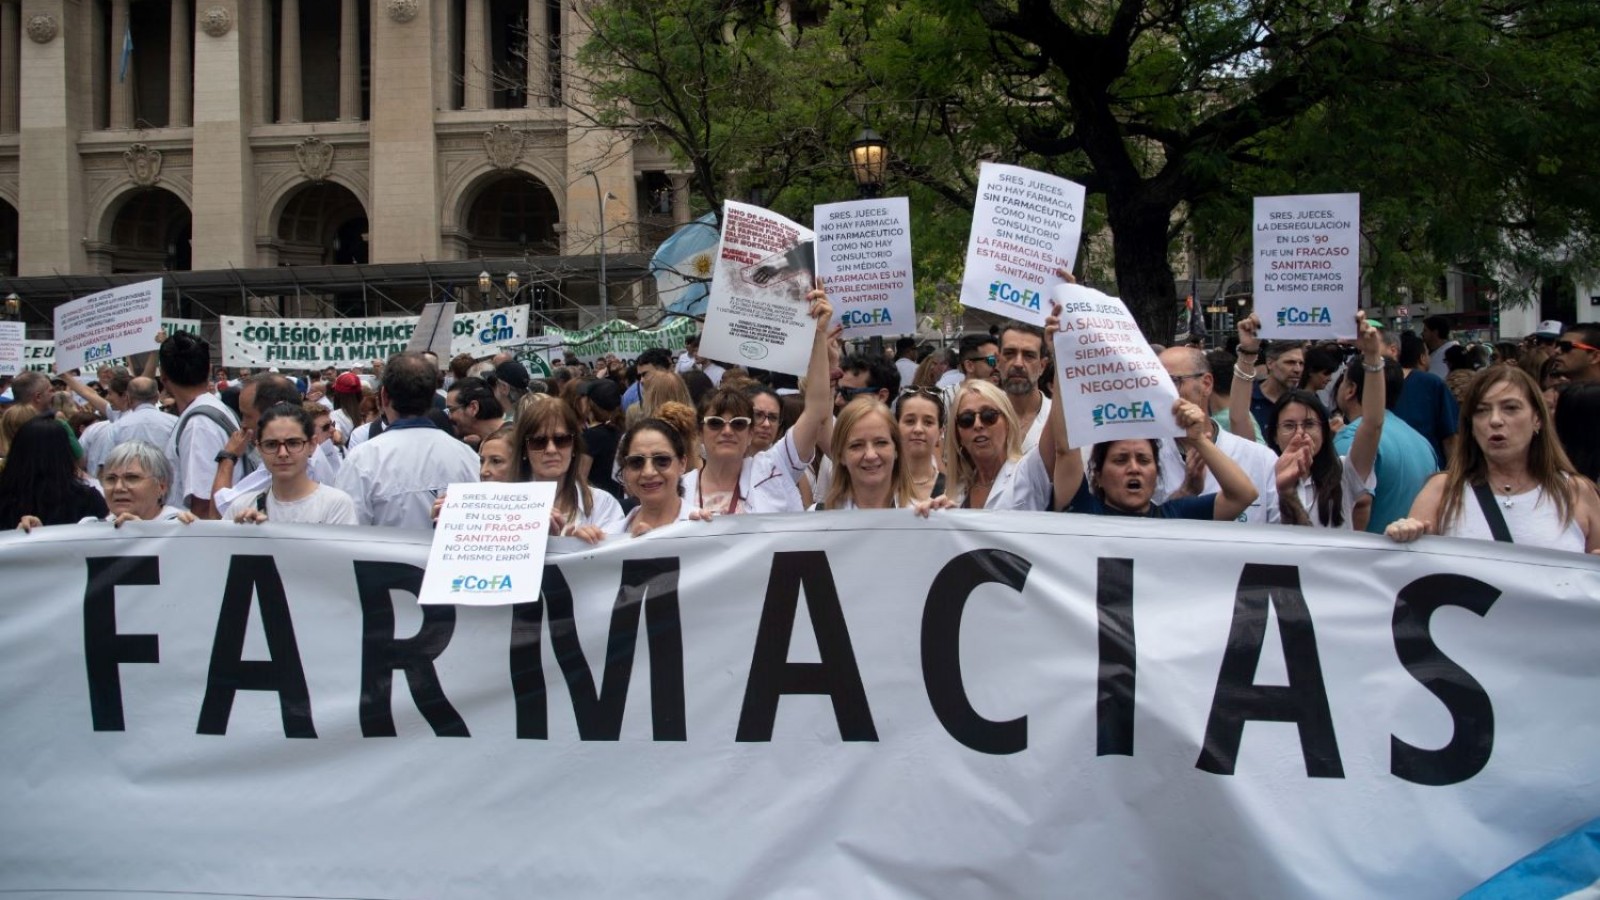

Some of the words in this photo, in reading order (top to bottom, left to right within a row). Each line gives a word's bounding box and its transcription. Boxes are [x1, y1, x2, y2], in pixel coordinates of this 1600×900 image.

[999, 174, 1026, 187] SRES.
[983, 192, 1000, 202] SIN
[1005, 186, 1025, 196] HAY
[1026, 191, 1073, 210] FARMACIA
[728, 208, 745, 217] UNO
[830, 211, 852, 220] SRES.
[994, 206, 1025, 219] COMO
[1027, 214, 1041, 223] NO
[1044, 220, 1062, 230] HAY
[1297, 210, 1334, 219] JUECES:
[855, 218, 899, 229] FARMACIA
[992, 217, 1060, 241] CONSULTORIO
[1258, 223, 1268, 231] LA
[996, 229, 1013, 239] SIN
[832, 242, 857, 251] COMO
[860, 241, 873, 249] NO
[977, 236, 989, 246] LA
[992, 239, 1039, 258] FARMACIA
[1042, 252, 1052, 262] ES
[1055, 257, 1068, 267] UN
[1296, 247, 1349, 256] FRACASO
[831, 250, 892, 262] CONSULTORIO
[834, 272, 878, 283] FARMACIA
[995, 264, 1044, 285] SANITARIO
[1281, 272, 1341, 280] COMETAMOS
[825, 282, 903, 294] ESTABLECIMIENTO
[842, 294, 888, 303] SANITARIO
[1066, 302, 1094, 313] SRES.
[1058, 322, 1074, 332] LA
[1076, 317, 1114, 329] SALUD
[244, 326, 321, 343] COLEGIO
[1079, 333, 1105, 345] QUE
[266, 345, 319, 361] FILIAL
[324, 346, 344, 361] LA
[1075, 346, 1128, 360] SIEMPRE
[1066, 361, 1125, 379] ENCIMA
[1128, 362, 1143, 372] DE
[1081, 376, 1159, 394] NEGOCIOS
[484, 521, 541, 532] FRACASO
[496, 553, 530, 561] ERROR
[84, 548, 1502, 786] FARMACIAS
